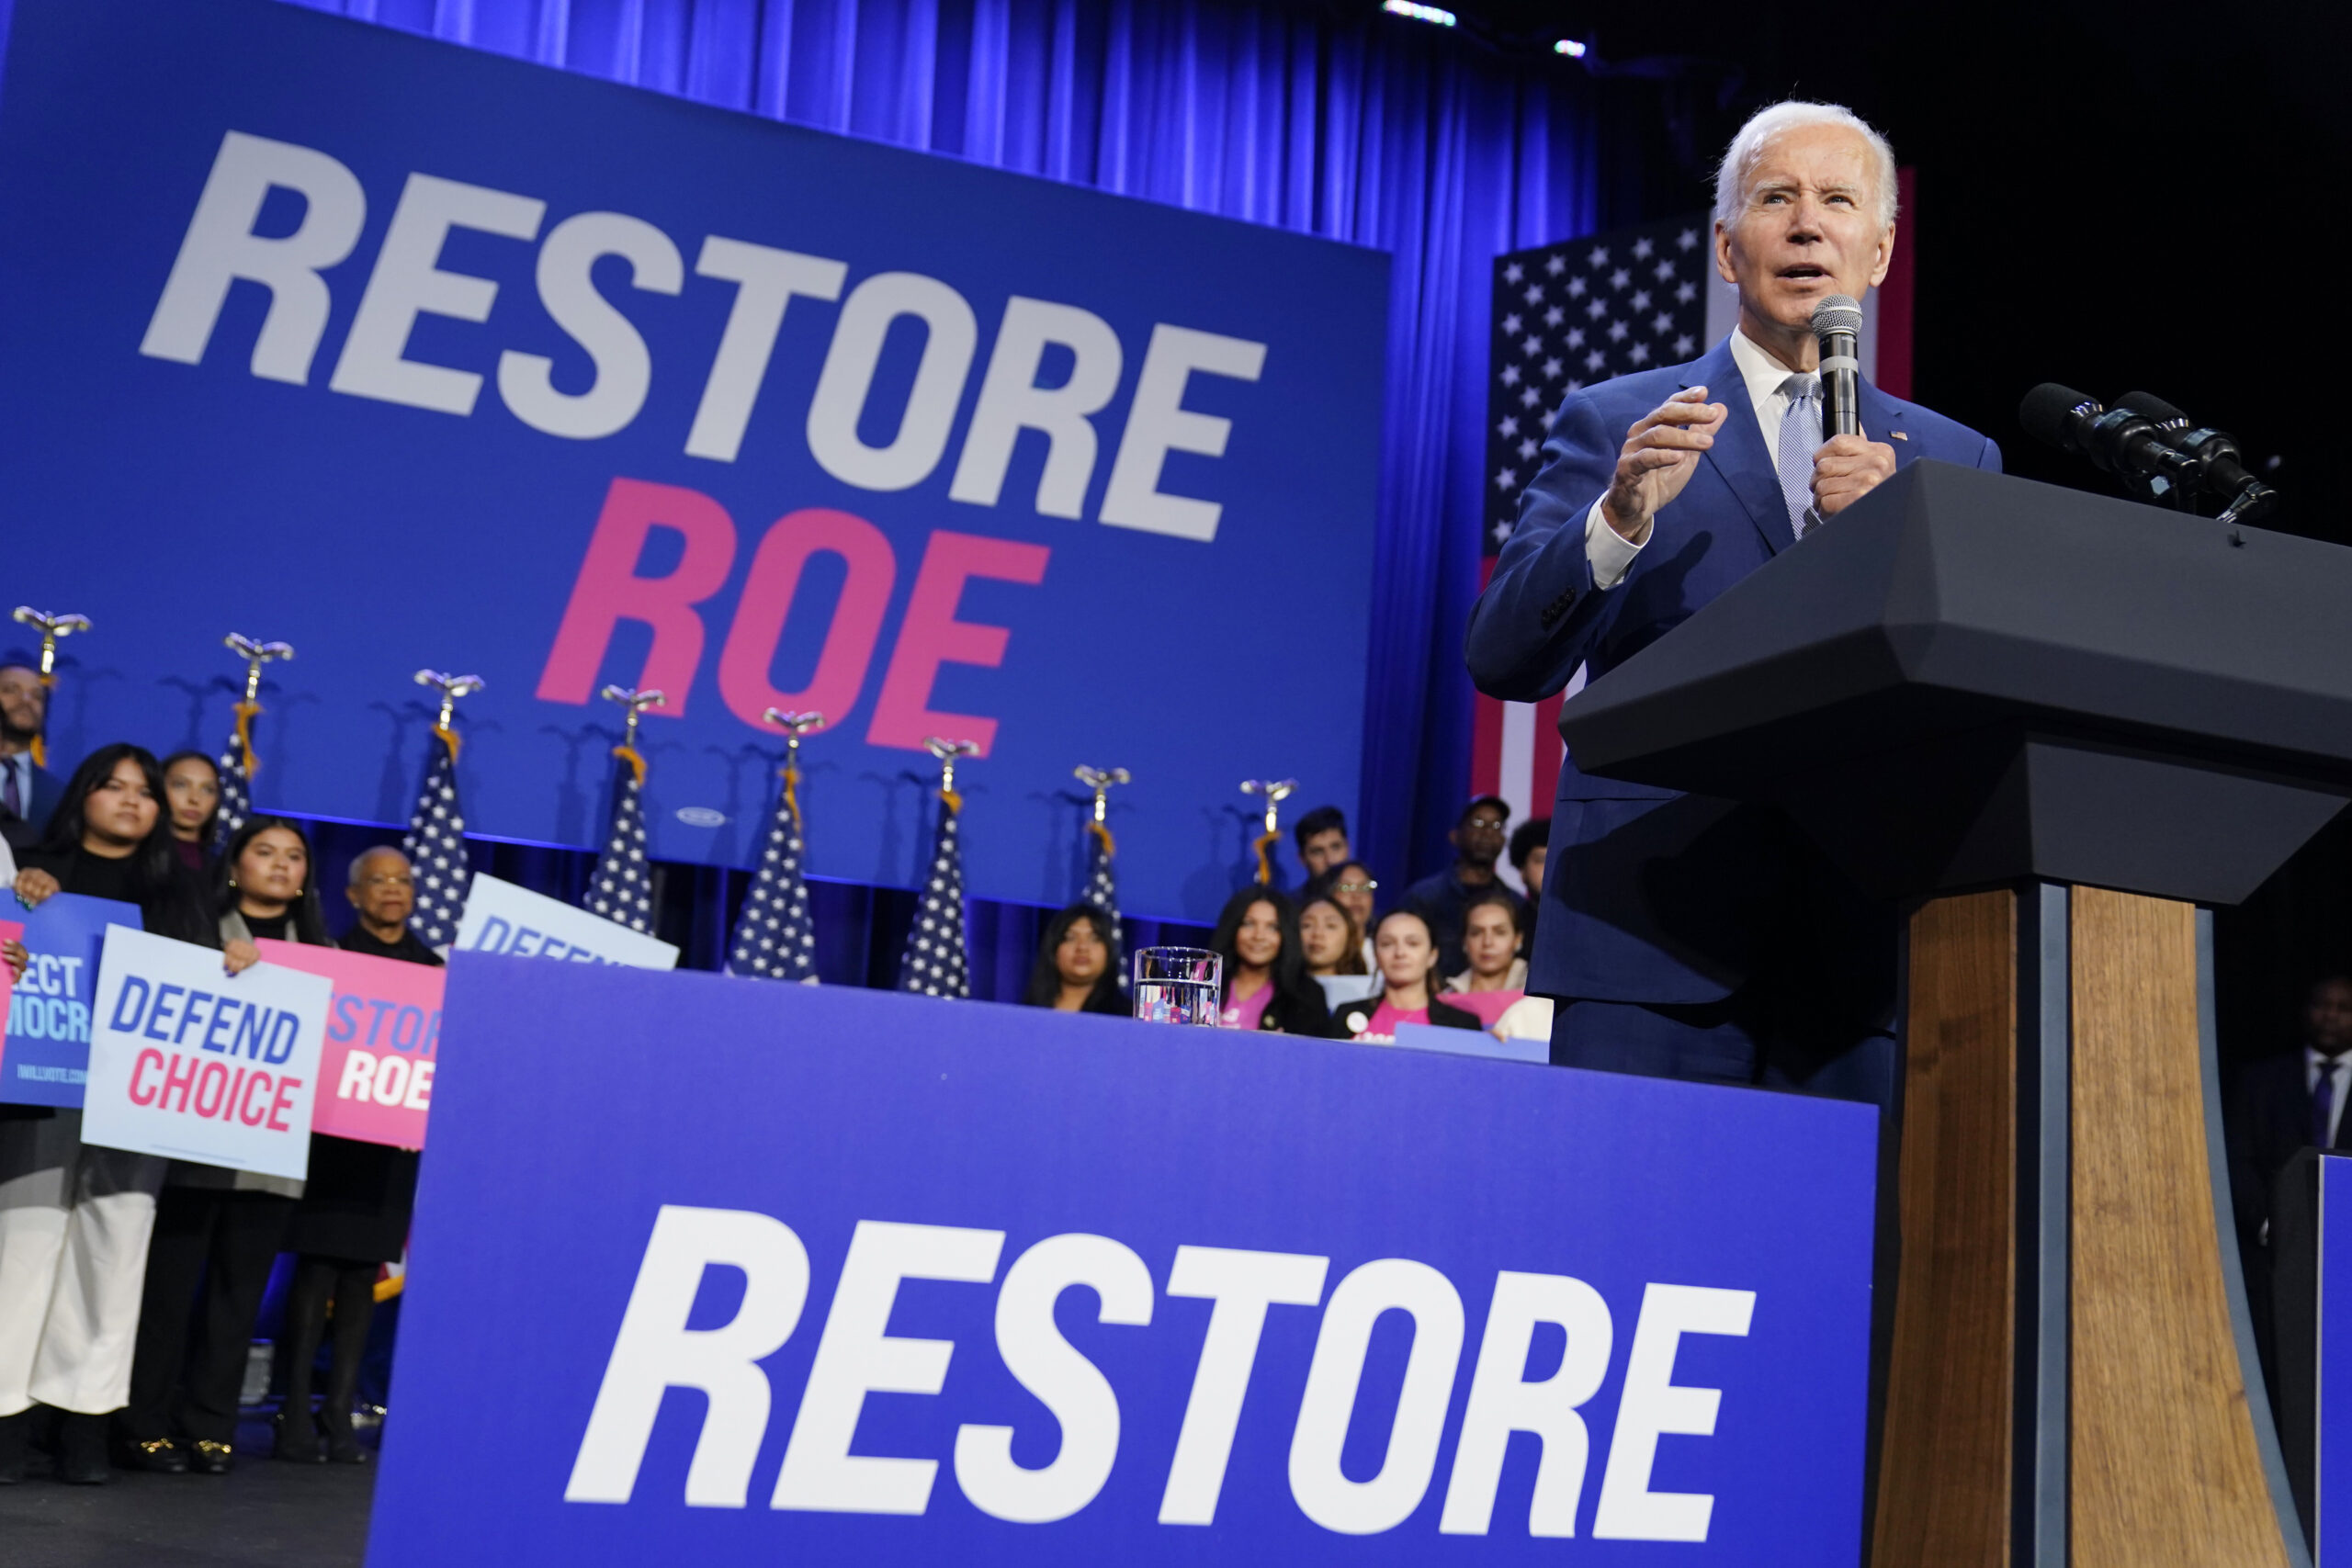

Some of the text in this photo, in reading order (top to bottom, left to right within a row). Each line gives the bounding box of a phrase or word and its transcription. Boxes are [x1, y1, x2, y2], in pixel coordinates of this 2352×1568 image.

[140, 131, 1267, 543] RESTORE
[536, 477, 1049, 759] ROE
[108, 975, 300, 1066] DEFEND
[128, 1047, 302, 1133] CHOICE
[336, 1049, 436, 1111] ROE
[564, 1204, 1757, 1542] RESTORE
